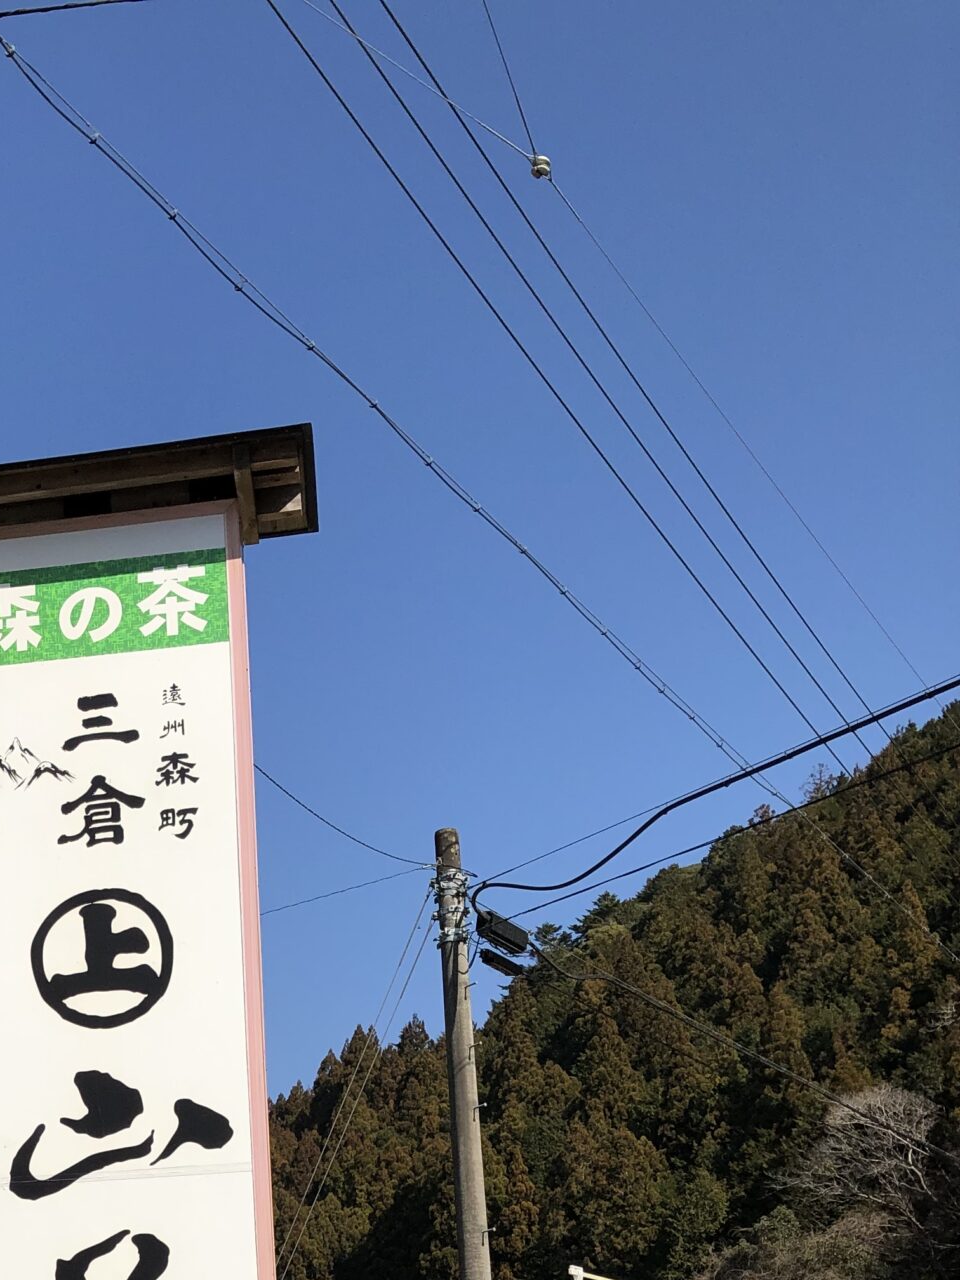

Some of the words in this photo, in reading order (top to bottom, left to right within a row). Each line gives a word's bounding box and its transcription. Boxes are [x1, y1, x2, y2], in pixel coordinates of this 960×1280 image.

[56, 693, 146, 848] 三倉
[155, 684, 199, 840] 遠州森町
